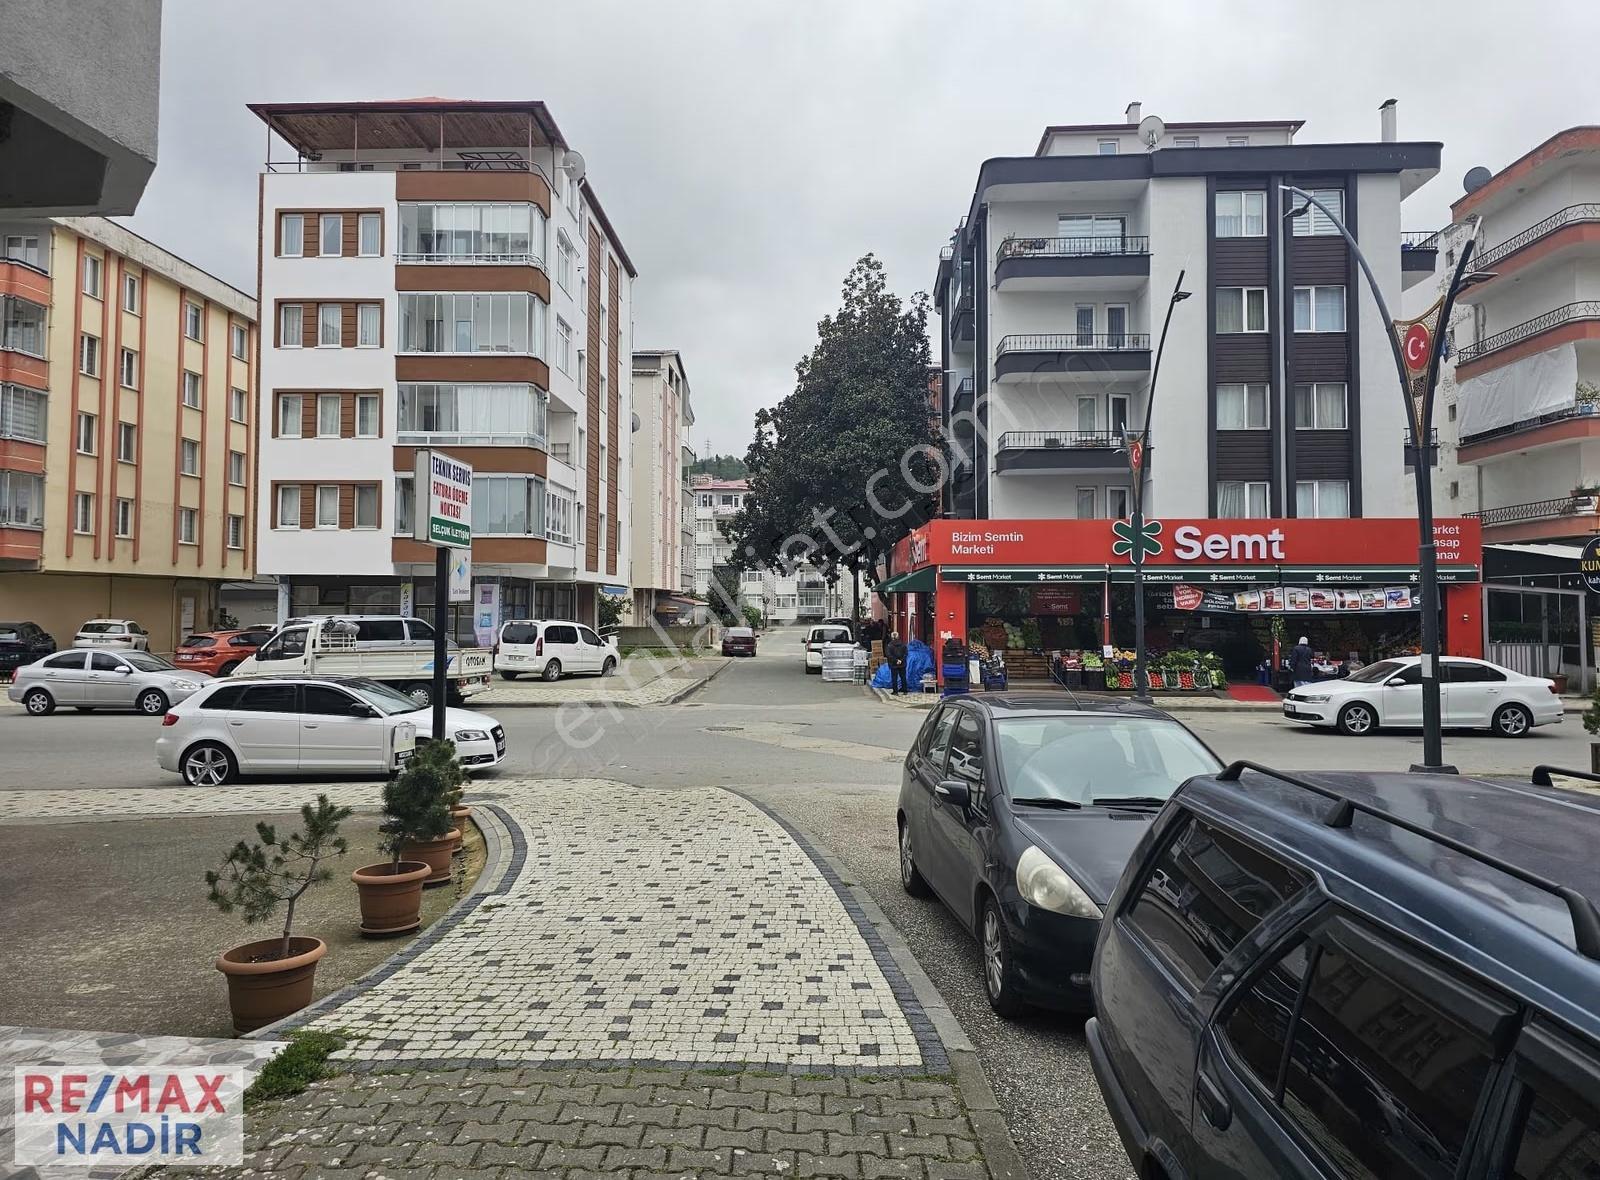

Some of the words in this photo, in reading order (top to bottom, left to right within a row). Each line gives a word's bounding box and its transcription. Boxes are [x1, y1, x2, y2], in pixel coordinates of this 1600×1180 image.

[432, 456, 451, 479] TEKNİK
[453, 465, 470, 486] SERVİS
[440, 501, 461, 519] NOKTASI
[432, 524, 451, 536] SELÇUK
[1432, 525, 1460, 534] arket
[952, 532, 981, 542] Bizim
[985, 532, 1024, 542] Semtin
[1174, 526, 1285, 560] Semt
[1433, 539, 1460, 548] asap
[952, 544, 994, 554] Marketi
